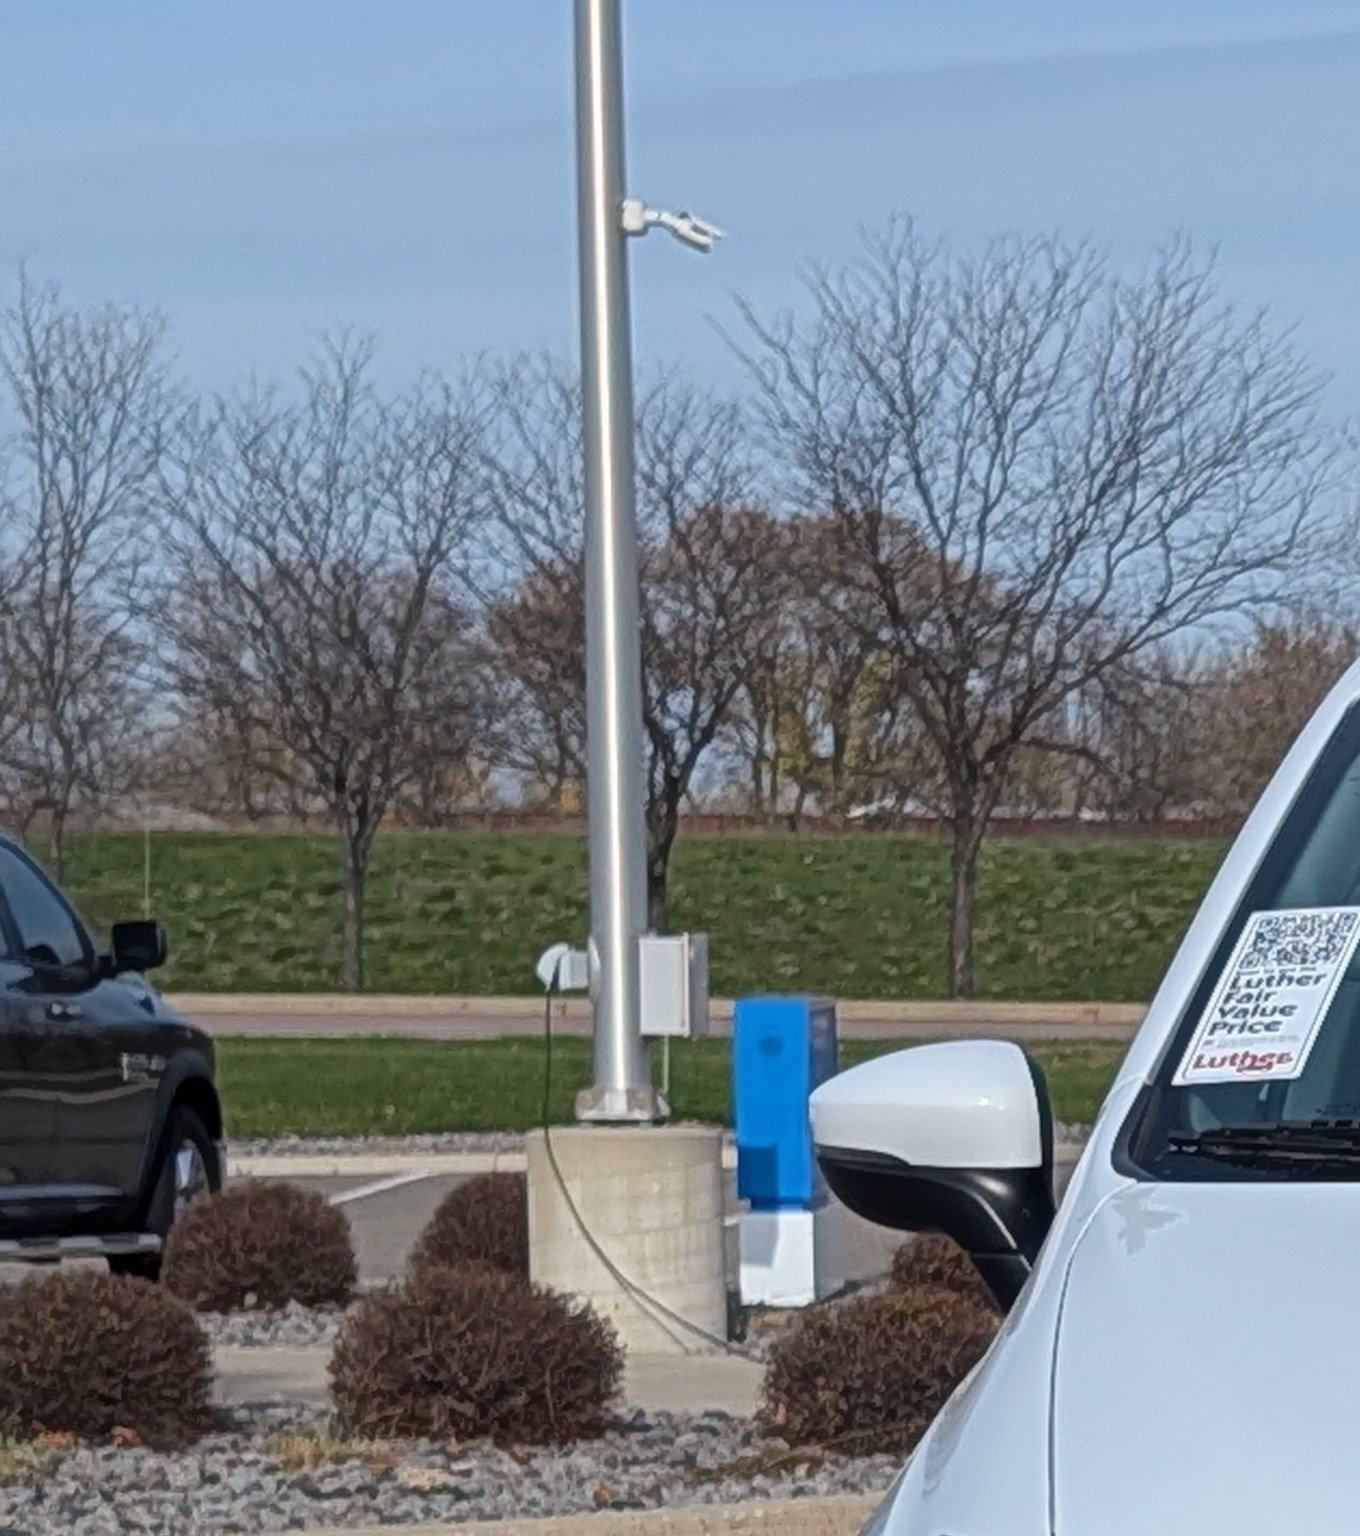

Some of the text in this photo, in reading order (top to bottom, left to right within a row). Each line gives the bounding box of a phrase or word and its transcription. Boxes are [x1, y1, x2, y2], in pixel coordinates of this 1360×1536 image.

[1229, 972, 1327, 990] Luther
[1223, 989, 1277, 1004] Fair
[1218, 1004, 1298, 1019] Value
[1208, 1021, 1282, 1036] Price
